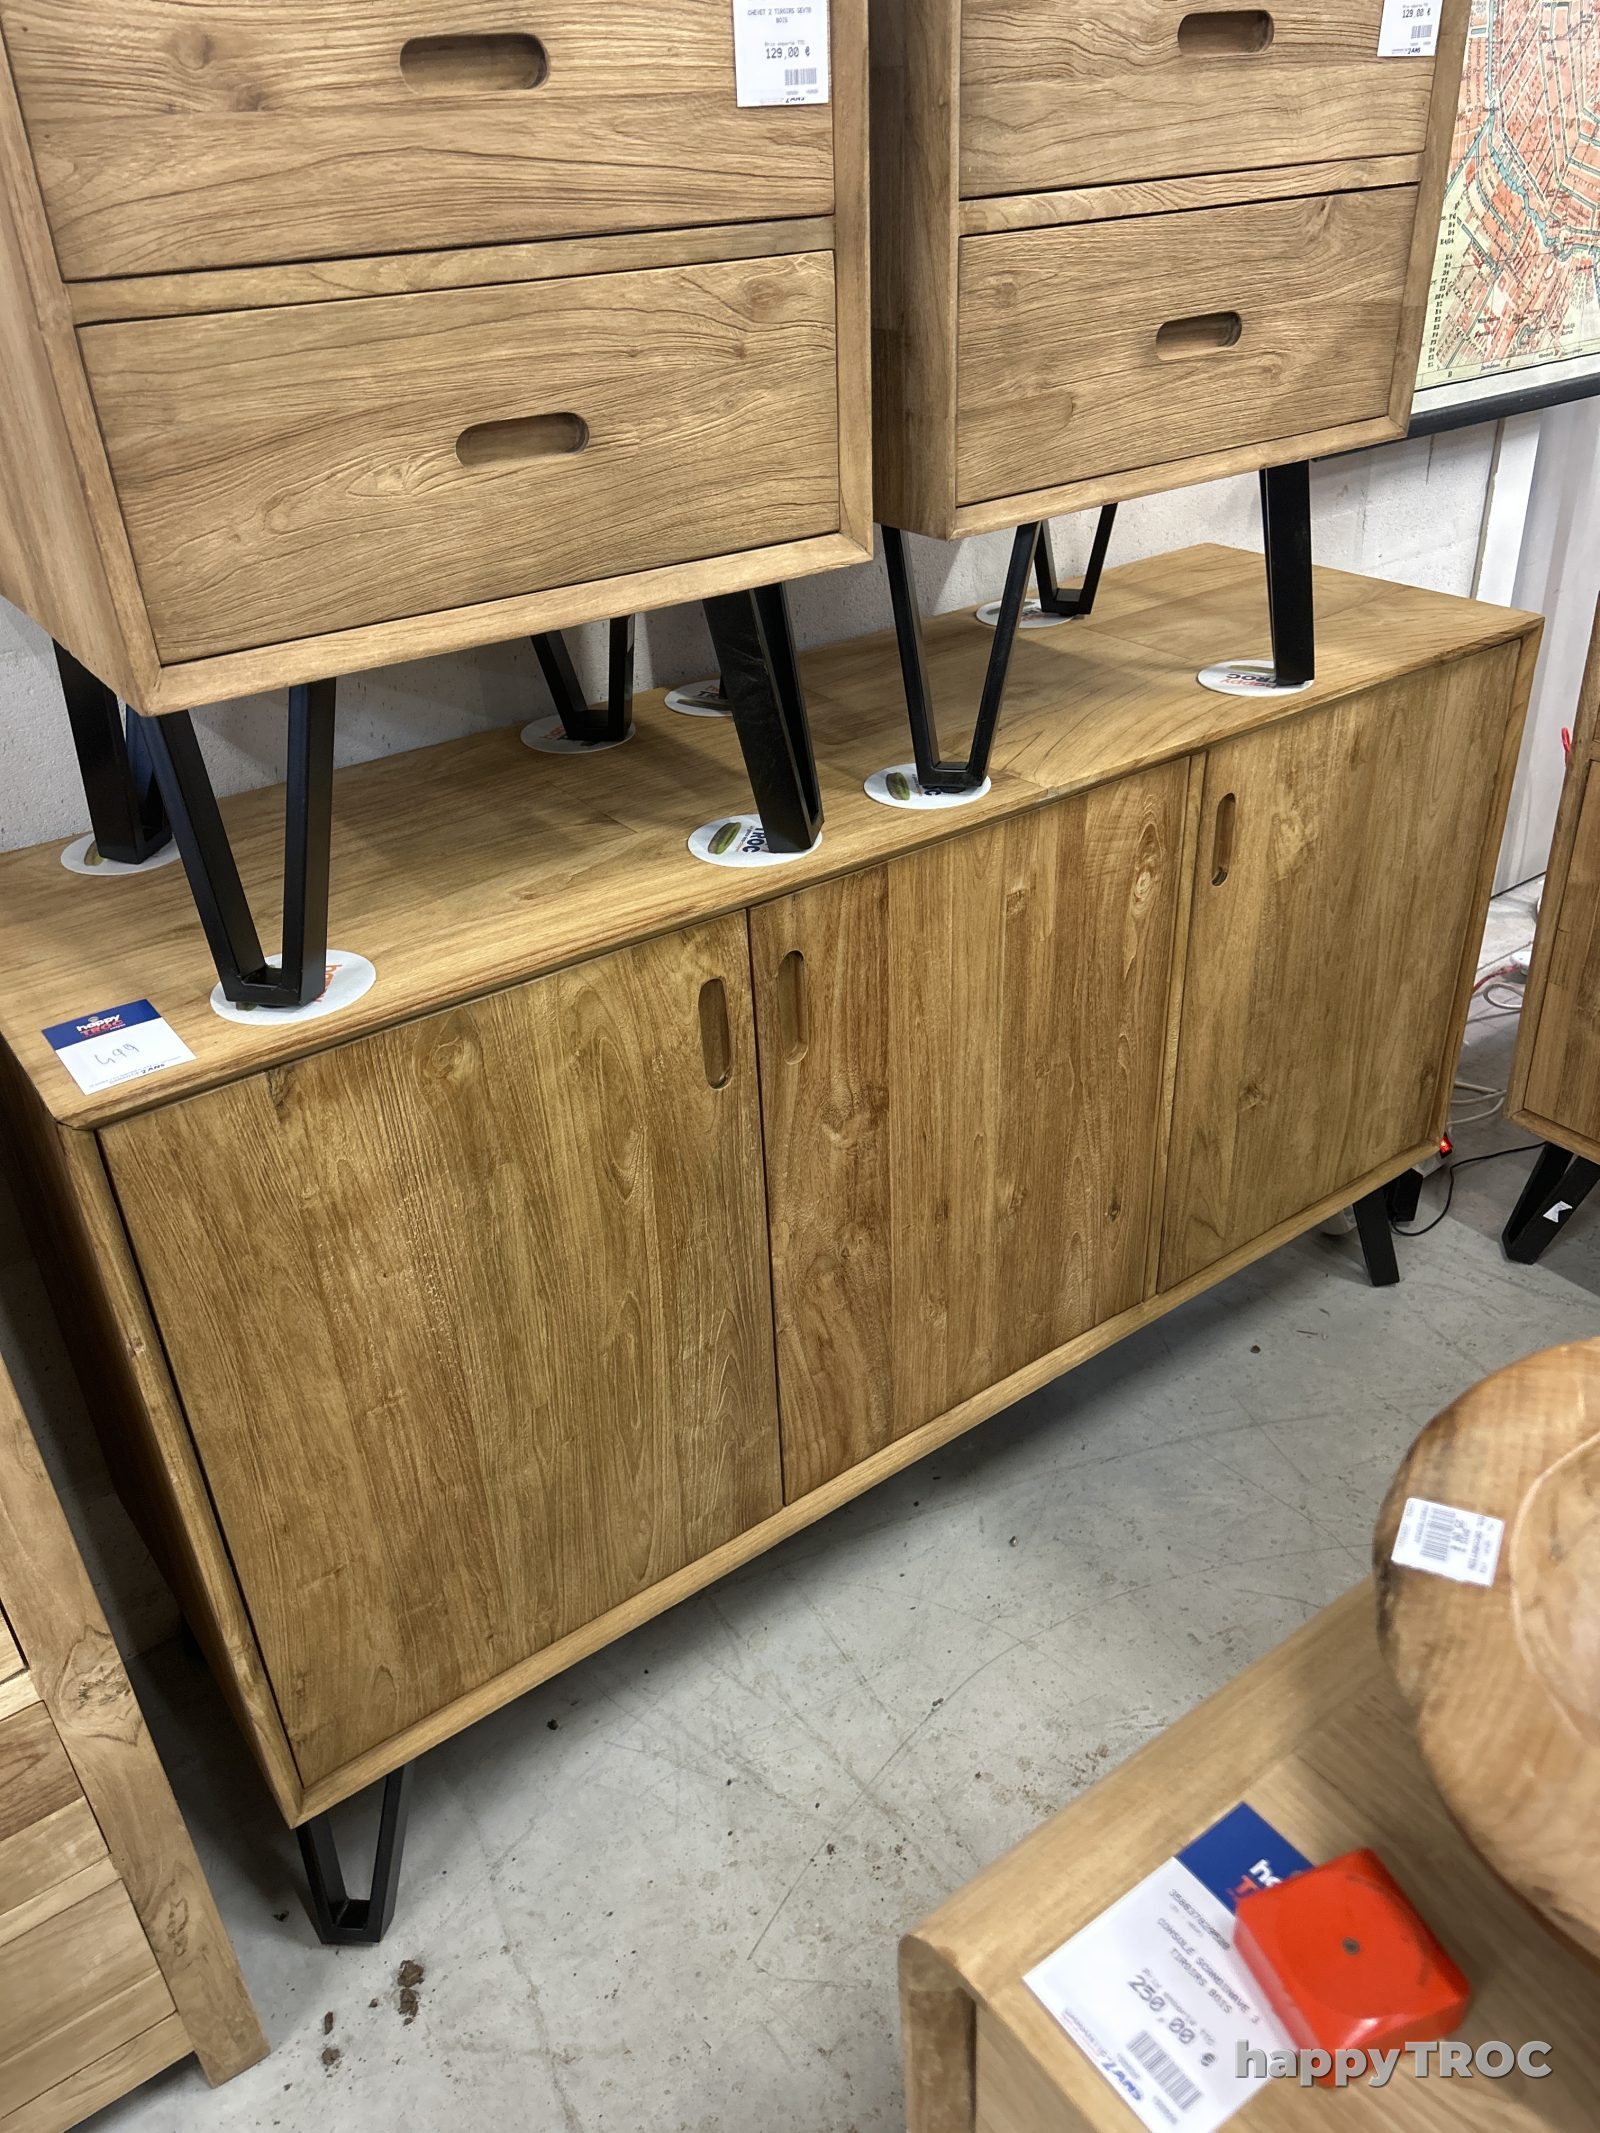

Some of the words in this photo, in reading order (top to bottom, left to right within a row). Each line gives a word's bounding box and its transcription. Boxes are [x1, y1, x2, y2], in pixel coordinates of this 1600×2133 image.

[766, 47, 799, 60] 129,00
[76, 1014, 120, 1032] happy
[81, 1020, 124, 1037] TROC
[1157, 1918, 1195, 1956] CONSOLE
[1170, 1948, 1207, 1986] TIROIRS
[1208, 1988, 1232, 2014] BOIS
[1128, 1975, 1195, 2044] 250,00
[1200, 2052, 1216, 2067] €
